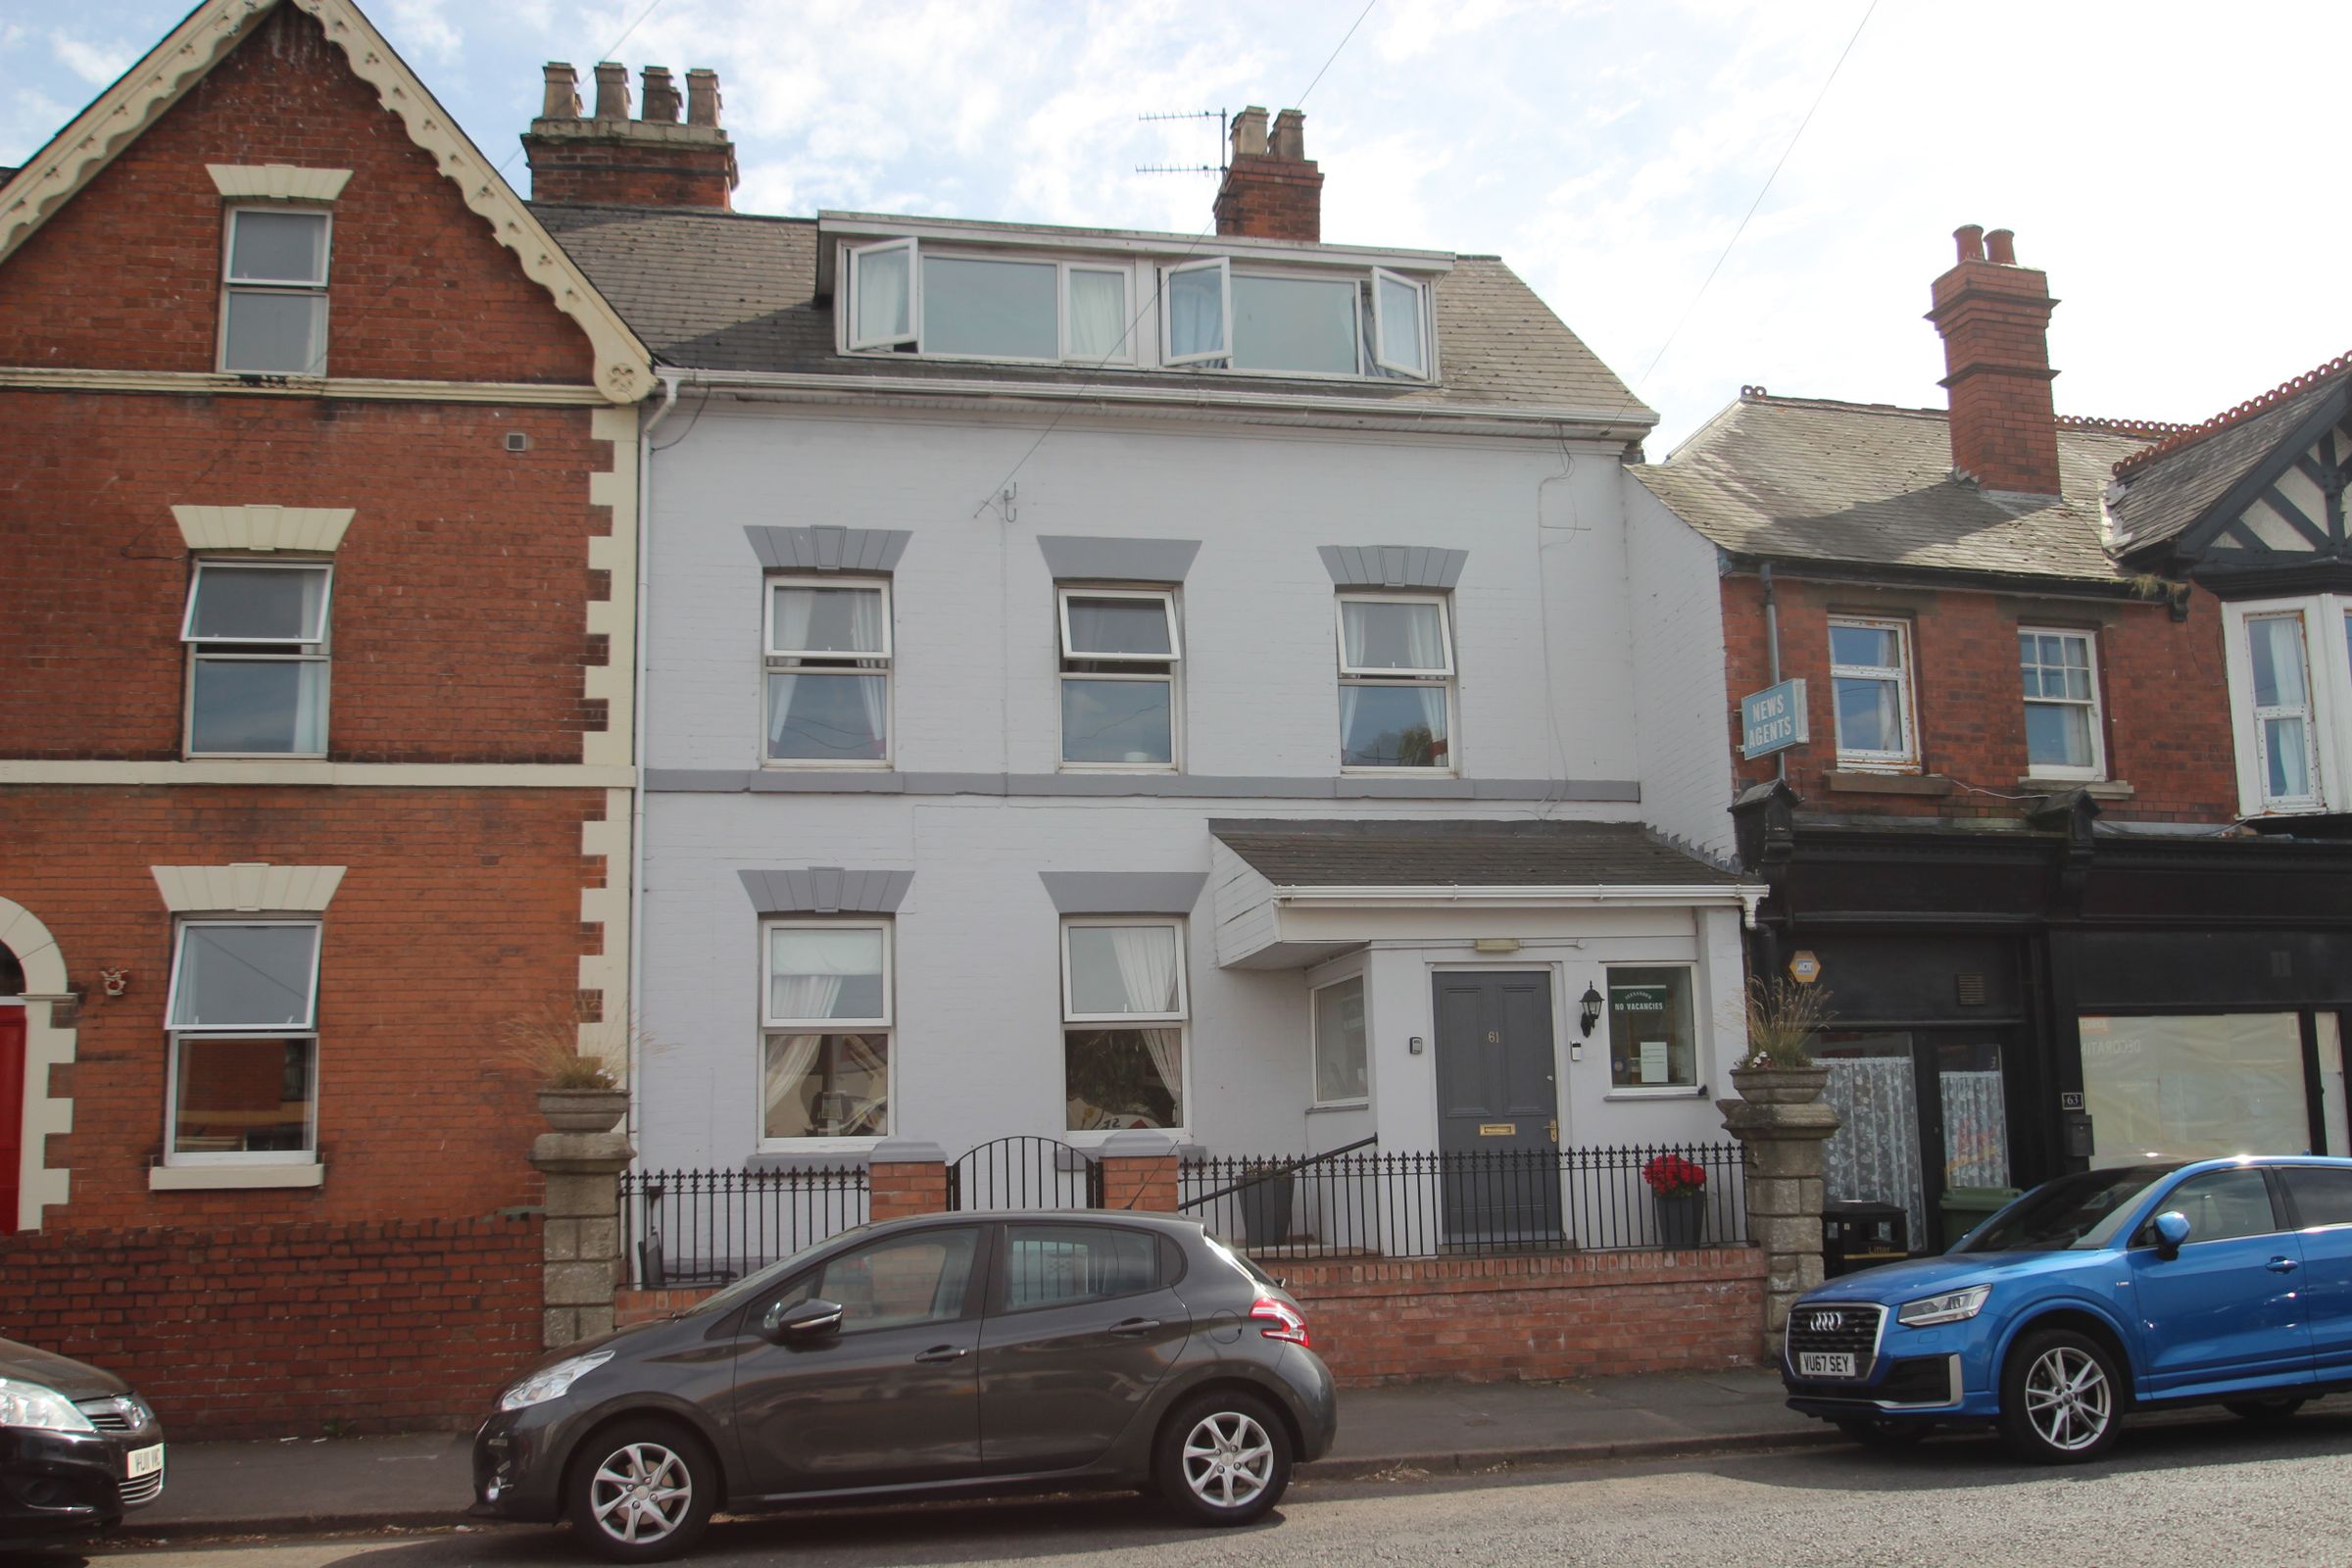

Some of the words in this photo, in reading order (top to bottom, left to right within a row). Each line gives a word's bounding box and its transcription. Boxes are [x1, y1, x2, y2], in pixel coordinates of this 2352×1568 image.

[1752, 694, 1784, 722] NEWS
[1748, 716, 1791, 749] AGENTS
[1626, 1002, 1663, 1010] VACANCIES
[1488, 1031, 1499, 1044] 61
[2067, 1095, 2079, 1104] 63
[1803, 1354, 1827, 1371] VU67
[1829, 1355, 1848, 1372] SEY
